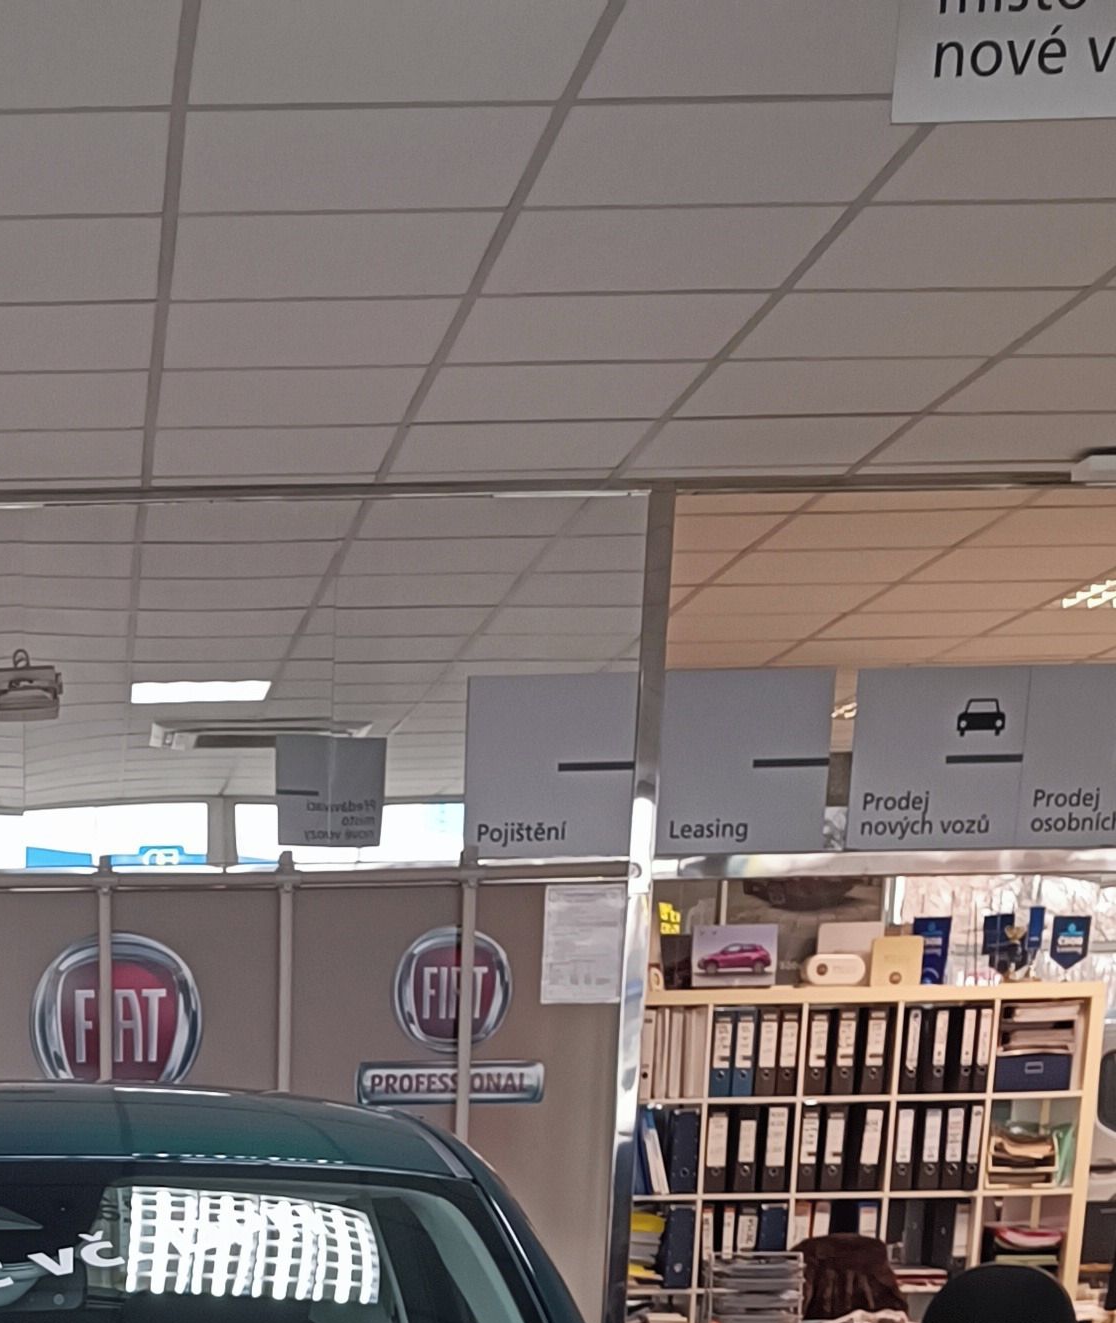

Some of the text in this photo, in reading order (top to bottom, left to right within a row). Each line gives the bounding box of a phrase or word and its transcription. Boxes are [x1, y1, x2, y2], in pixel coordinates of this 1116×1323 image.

[934, 25, 1067, 78] nové
[862, 791, 930, 814] Prodej
[1033, 787, 1100, 812] Prodej
[476, 820, 567, 848] Pojištění
[668, 818, 749, 842] Leasing
[860, 813, 990, 840] nových vozů
[74, 987, 167, 1063] FAT
[370, 1072, 527, 1094] PROFESSONAL
